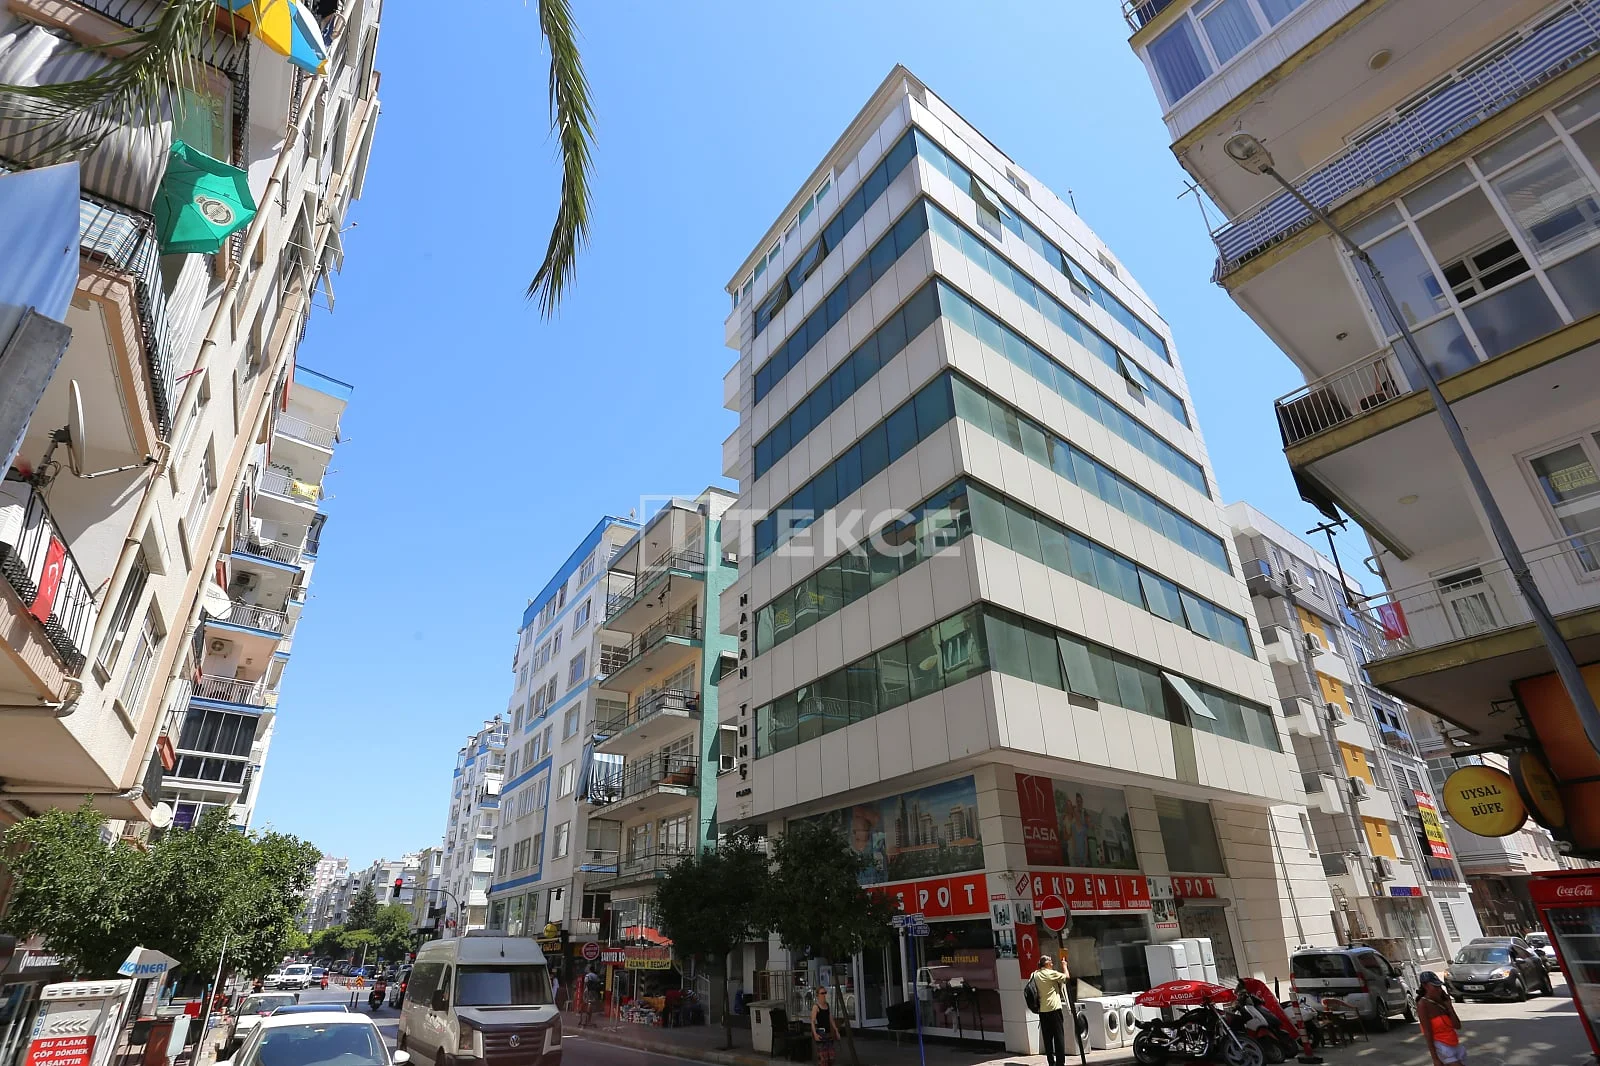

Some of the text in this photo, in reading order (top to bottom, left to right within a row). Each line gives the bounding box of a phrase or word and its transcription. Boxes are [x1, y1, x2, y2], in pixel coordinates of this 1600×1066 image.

[739, 594, 748, 680] HASAN
[739, 703, 748, 780] TUNÇ
[1460, 785, 1502, 800] UYSAL
[1471, 802, 1504, 816] BÜFE
[1023, 825, 1058, 842] CASA
[1033, 875, 1139, 896] AKDENİZ
[1174, 879, 1214, 896] SPOT
[896, 883, 975, 911] SPOT
[56, 1038, 87, 1047] ALANA
[33, 1048, 89, 1060] ÇÖP DÖKMEK
[35, 1058, 82, 1066] YASAKTIR
